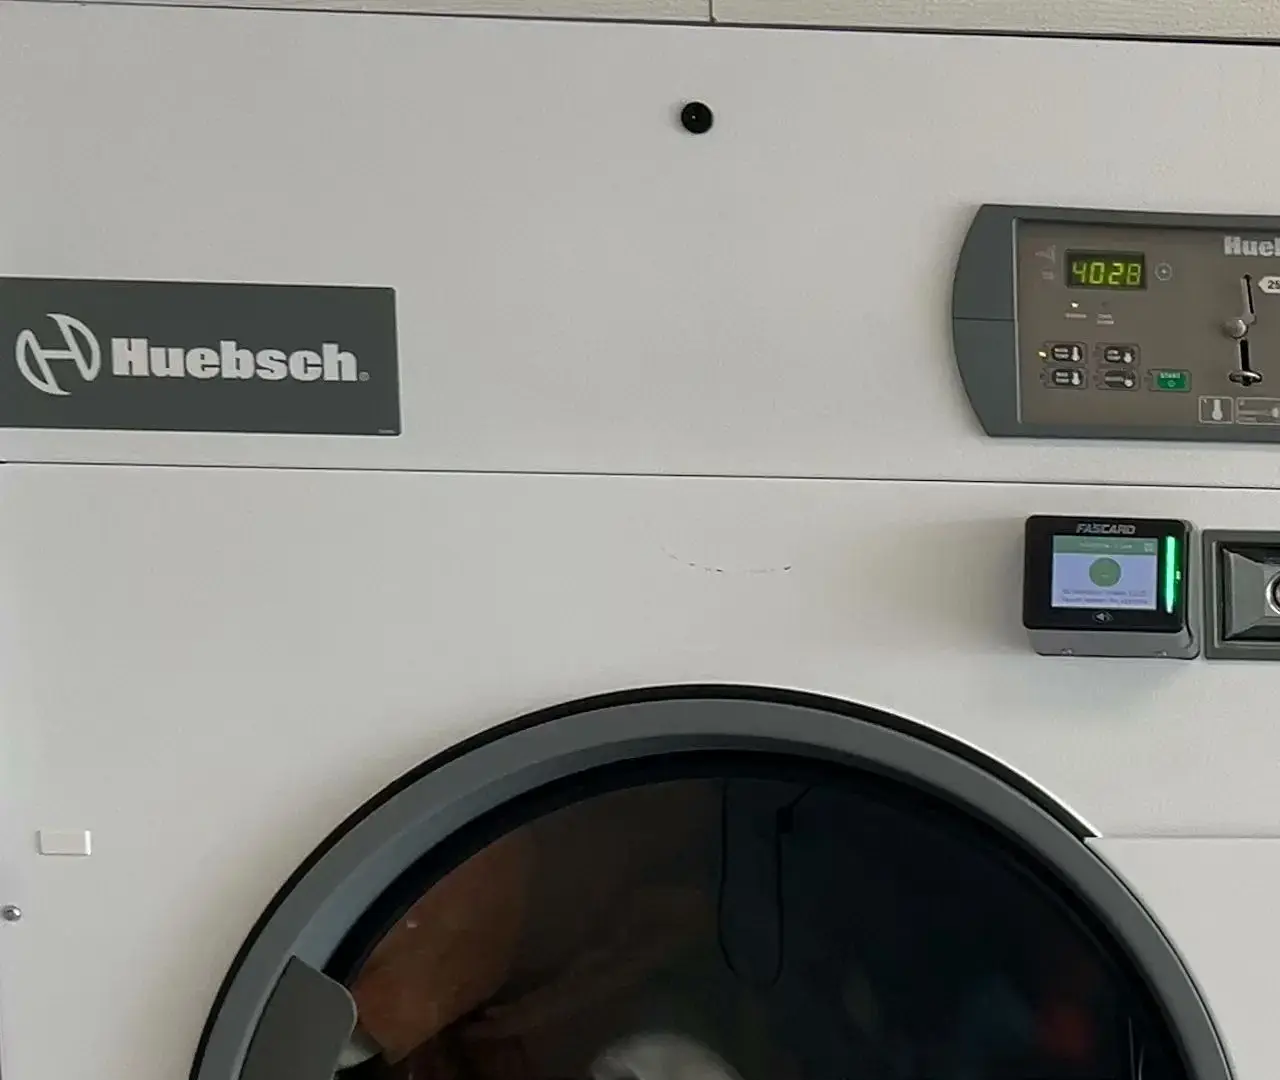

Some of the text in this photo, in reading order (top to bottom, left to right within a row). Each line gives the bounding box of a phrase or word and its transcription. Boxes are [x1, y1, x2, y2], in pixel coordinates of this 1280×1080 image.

[1071, 262, 1142, 286] 4028
[111, 337, 359, 382] Huebsch
[1076, 523, 1137, 535] FASCARD
